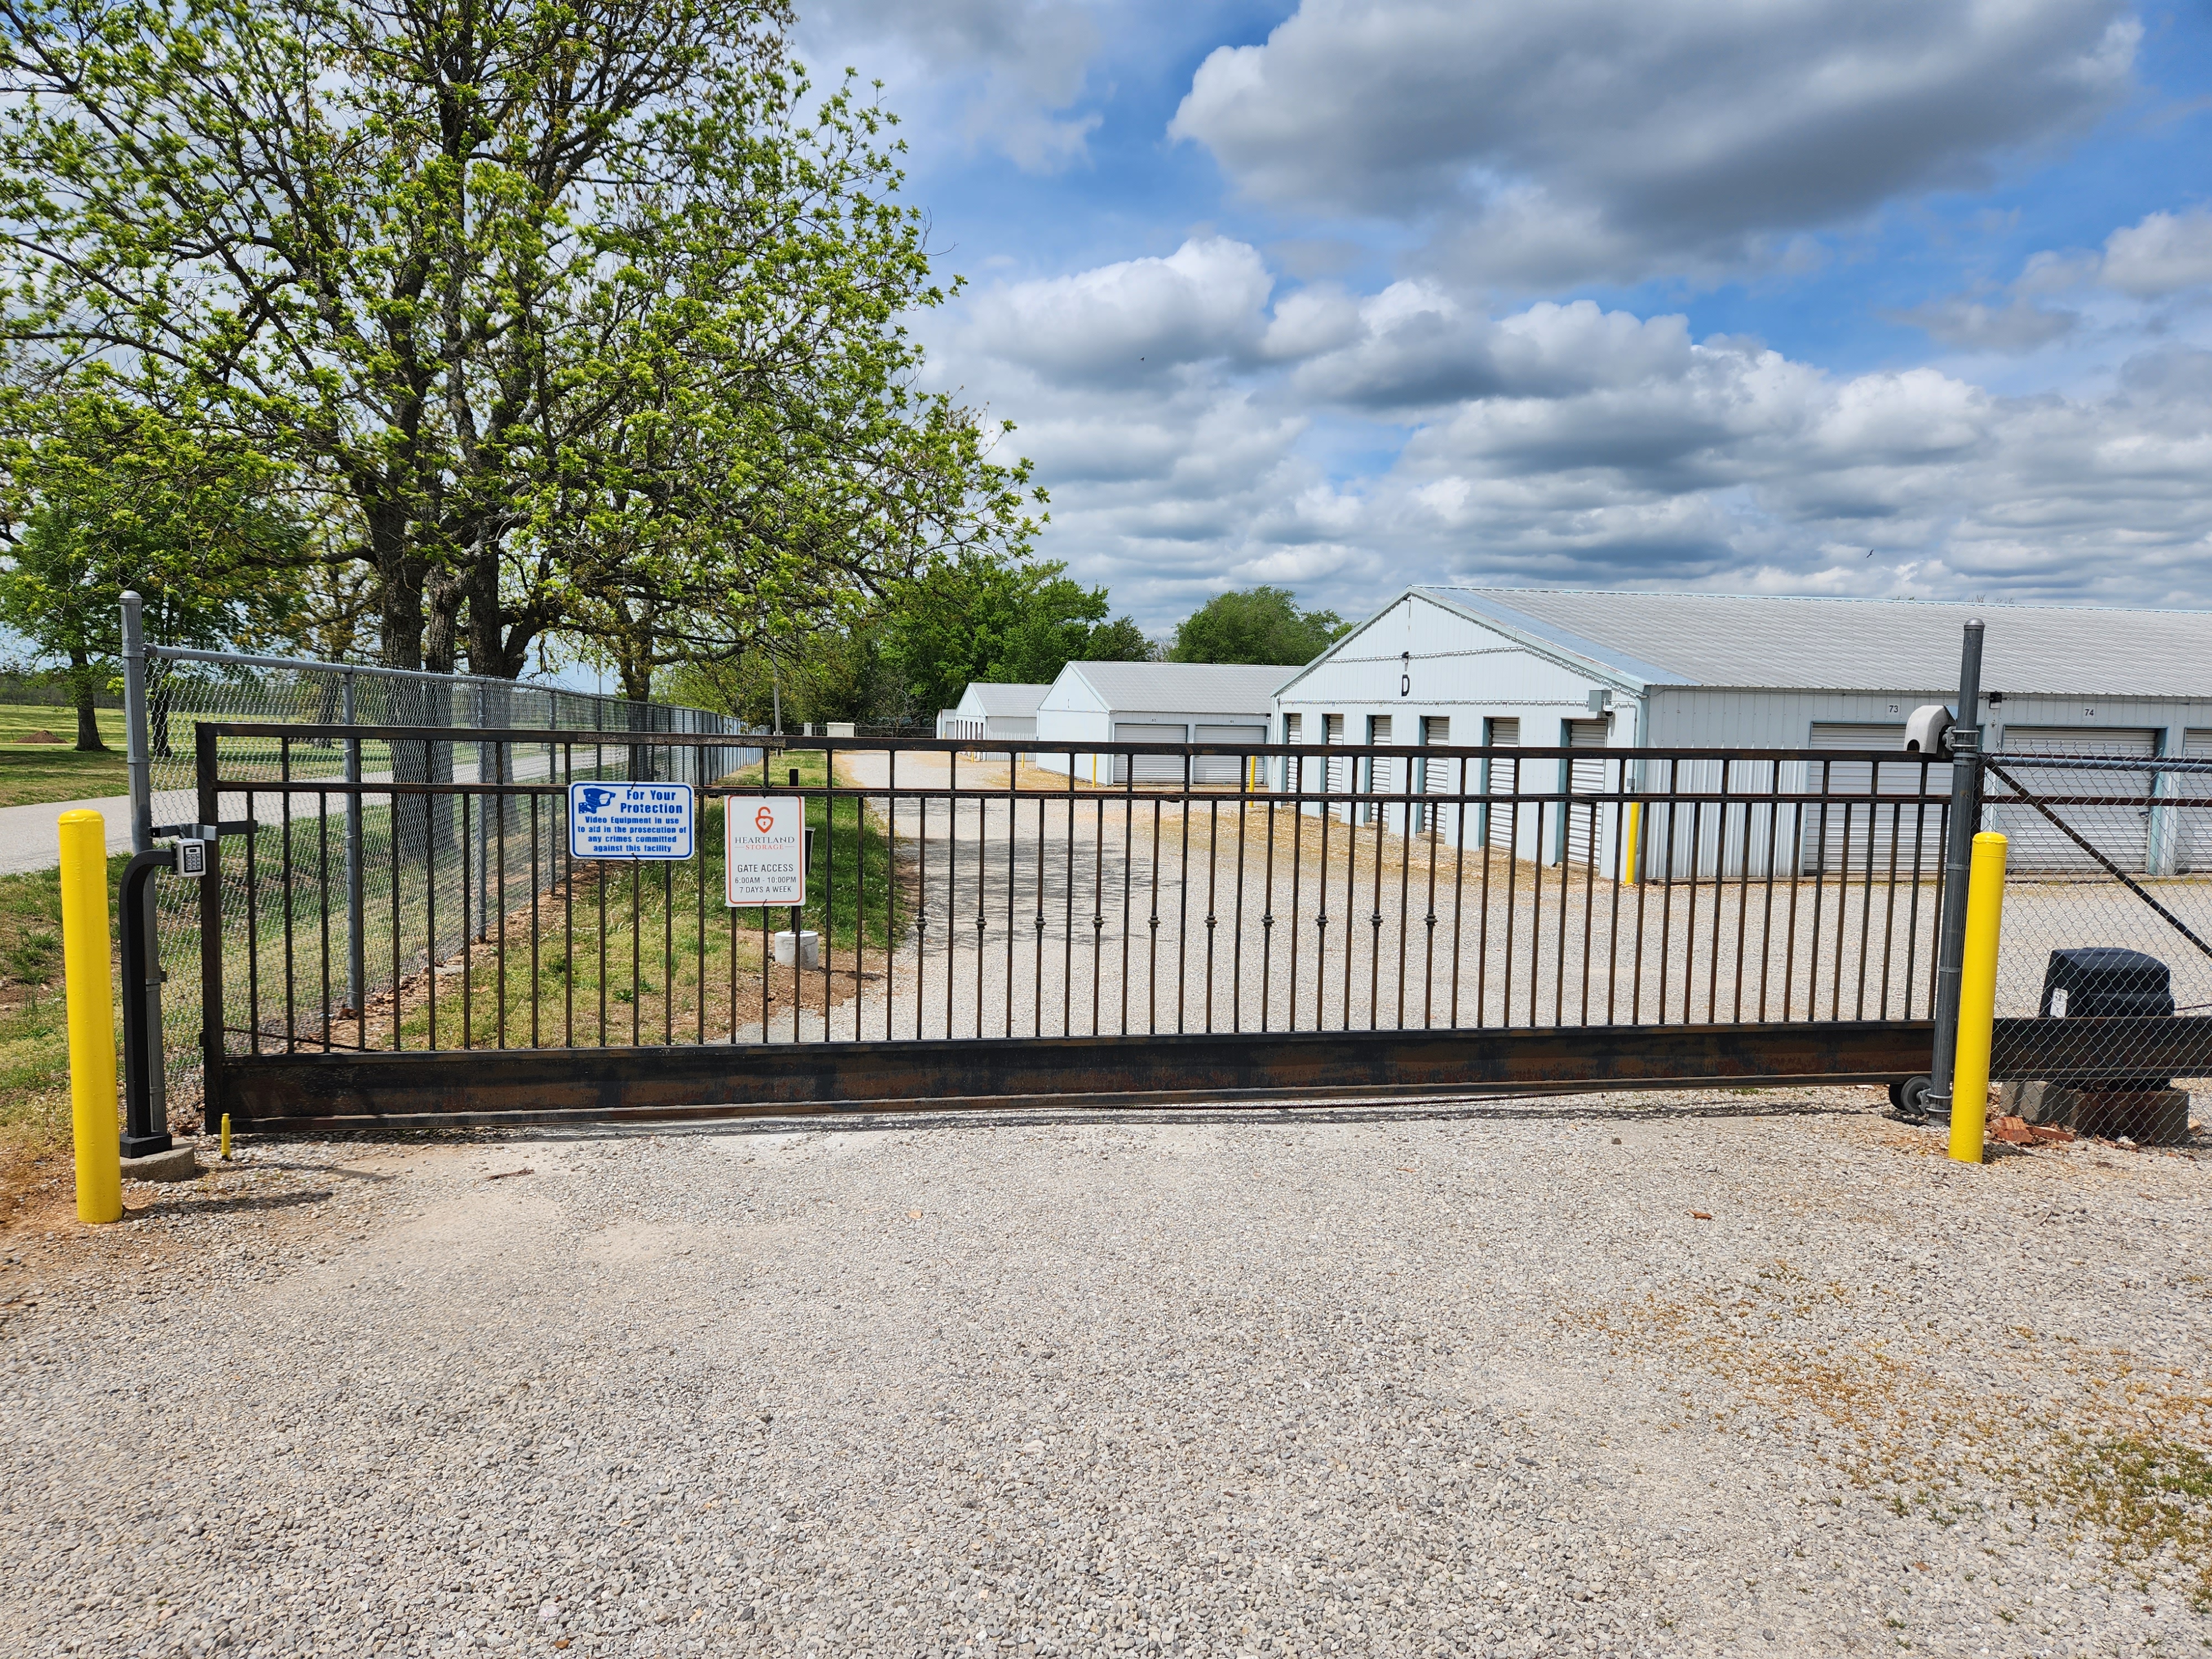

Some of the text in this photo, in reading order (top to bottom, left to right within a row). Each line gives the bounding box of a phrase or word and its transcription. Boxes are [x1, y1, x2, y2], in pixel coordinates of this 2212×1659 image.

[1401, 674, 1410, 697] D
[627, 790, 676, 801] For Your
[620, 803, 682, 813] Protection
